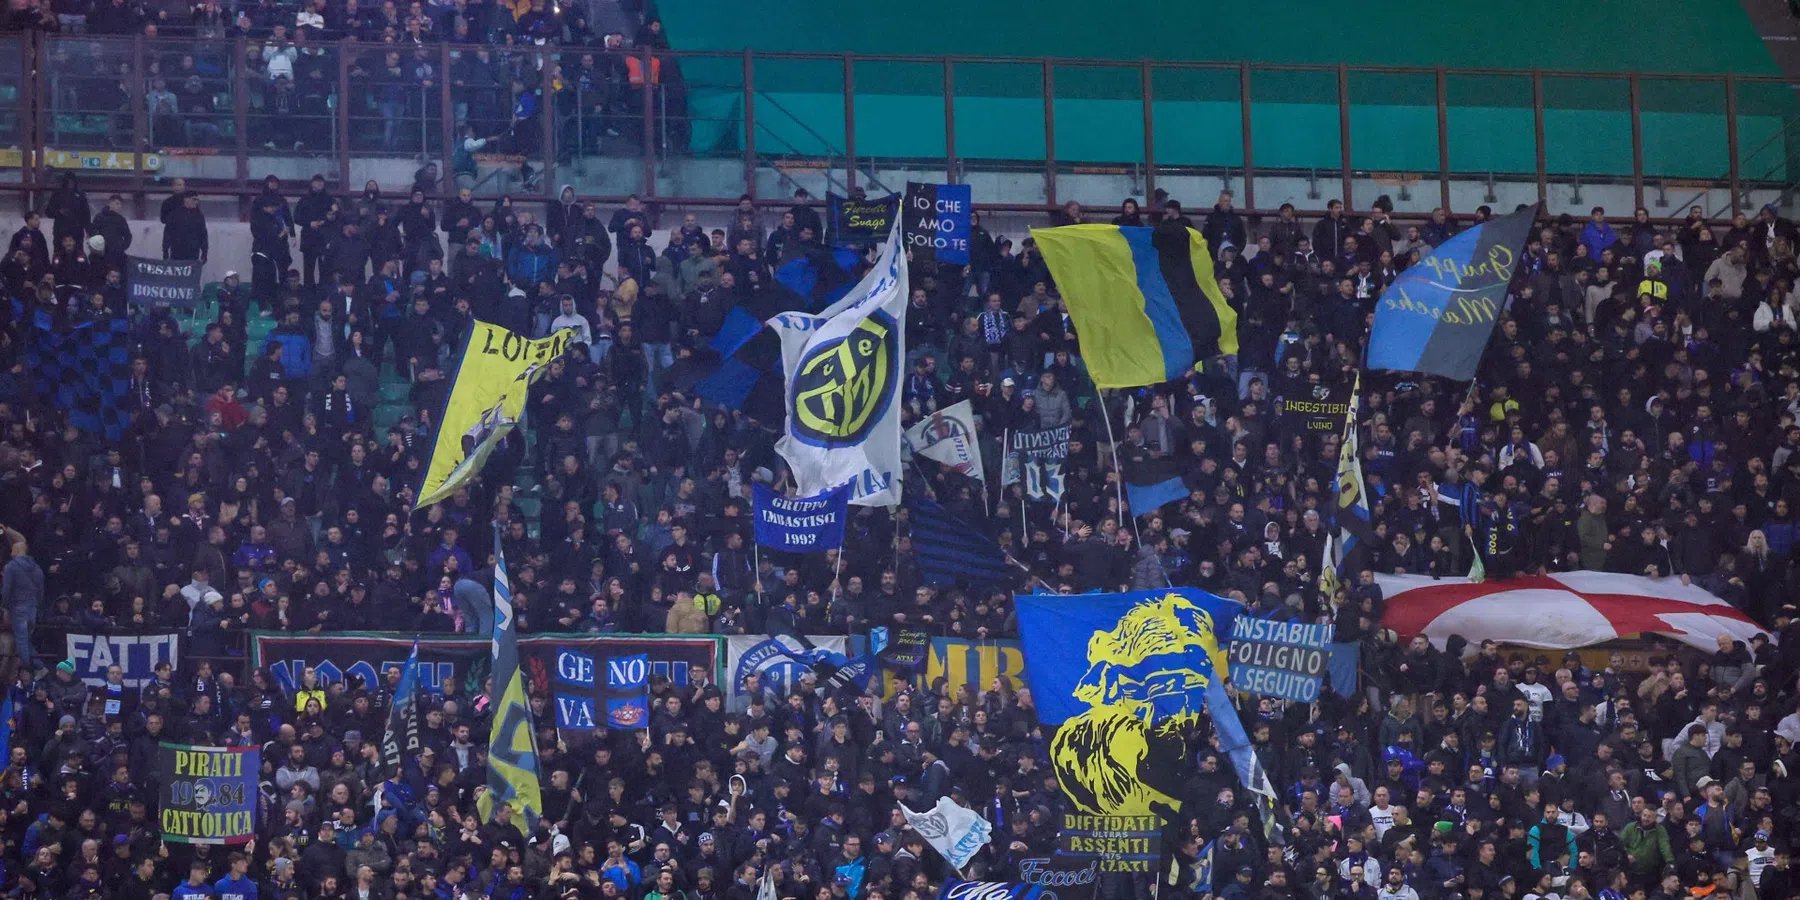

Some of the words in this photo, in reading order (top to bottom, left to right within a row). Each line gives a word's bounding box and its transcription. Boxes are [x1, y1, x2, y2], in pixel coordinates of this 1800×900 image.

[914, 196, 930, 210] IO
[935, 200, 961, 213] CHE
[918, 217, 955, 233] AMO
[907, 232, 947, 249] SOLO
[952, 239, 967, 251] TE
[137, 262, 192, 277] CESANO
[133, 283, 194, 300] BOSCONE
[1285, 400, 1348, 414] INGESTIBIL
[771, 497, 828, 512] GRUPPO
[762, 509, 836, 528] IMBASTISCI
[784, 532, 817, 545] 1993
[1488, 526, 1498, 555] 1908
[66, 633, 179, 673] FATTI
[1229, 640, 1322, 675] FOLIGNO
[1243, 668, 1317, 701] SEGUITO
[557, 697, 595, 727] VA
[174, 750, 243, 777] PIRATI
[162, 808, 253, 838] CATTOLICA
[1064, 814, 1156, 832] DIFFIDATI
[1092, 830, 1128, 838] ULTRAS
[1070, 836, 1149, 854] ASSENTI
[1019, 857, 1098, 887] Eccoci
